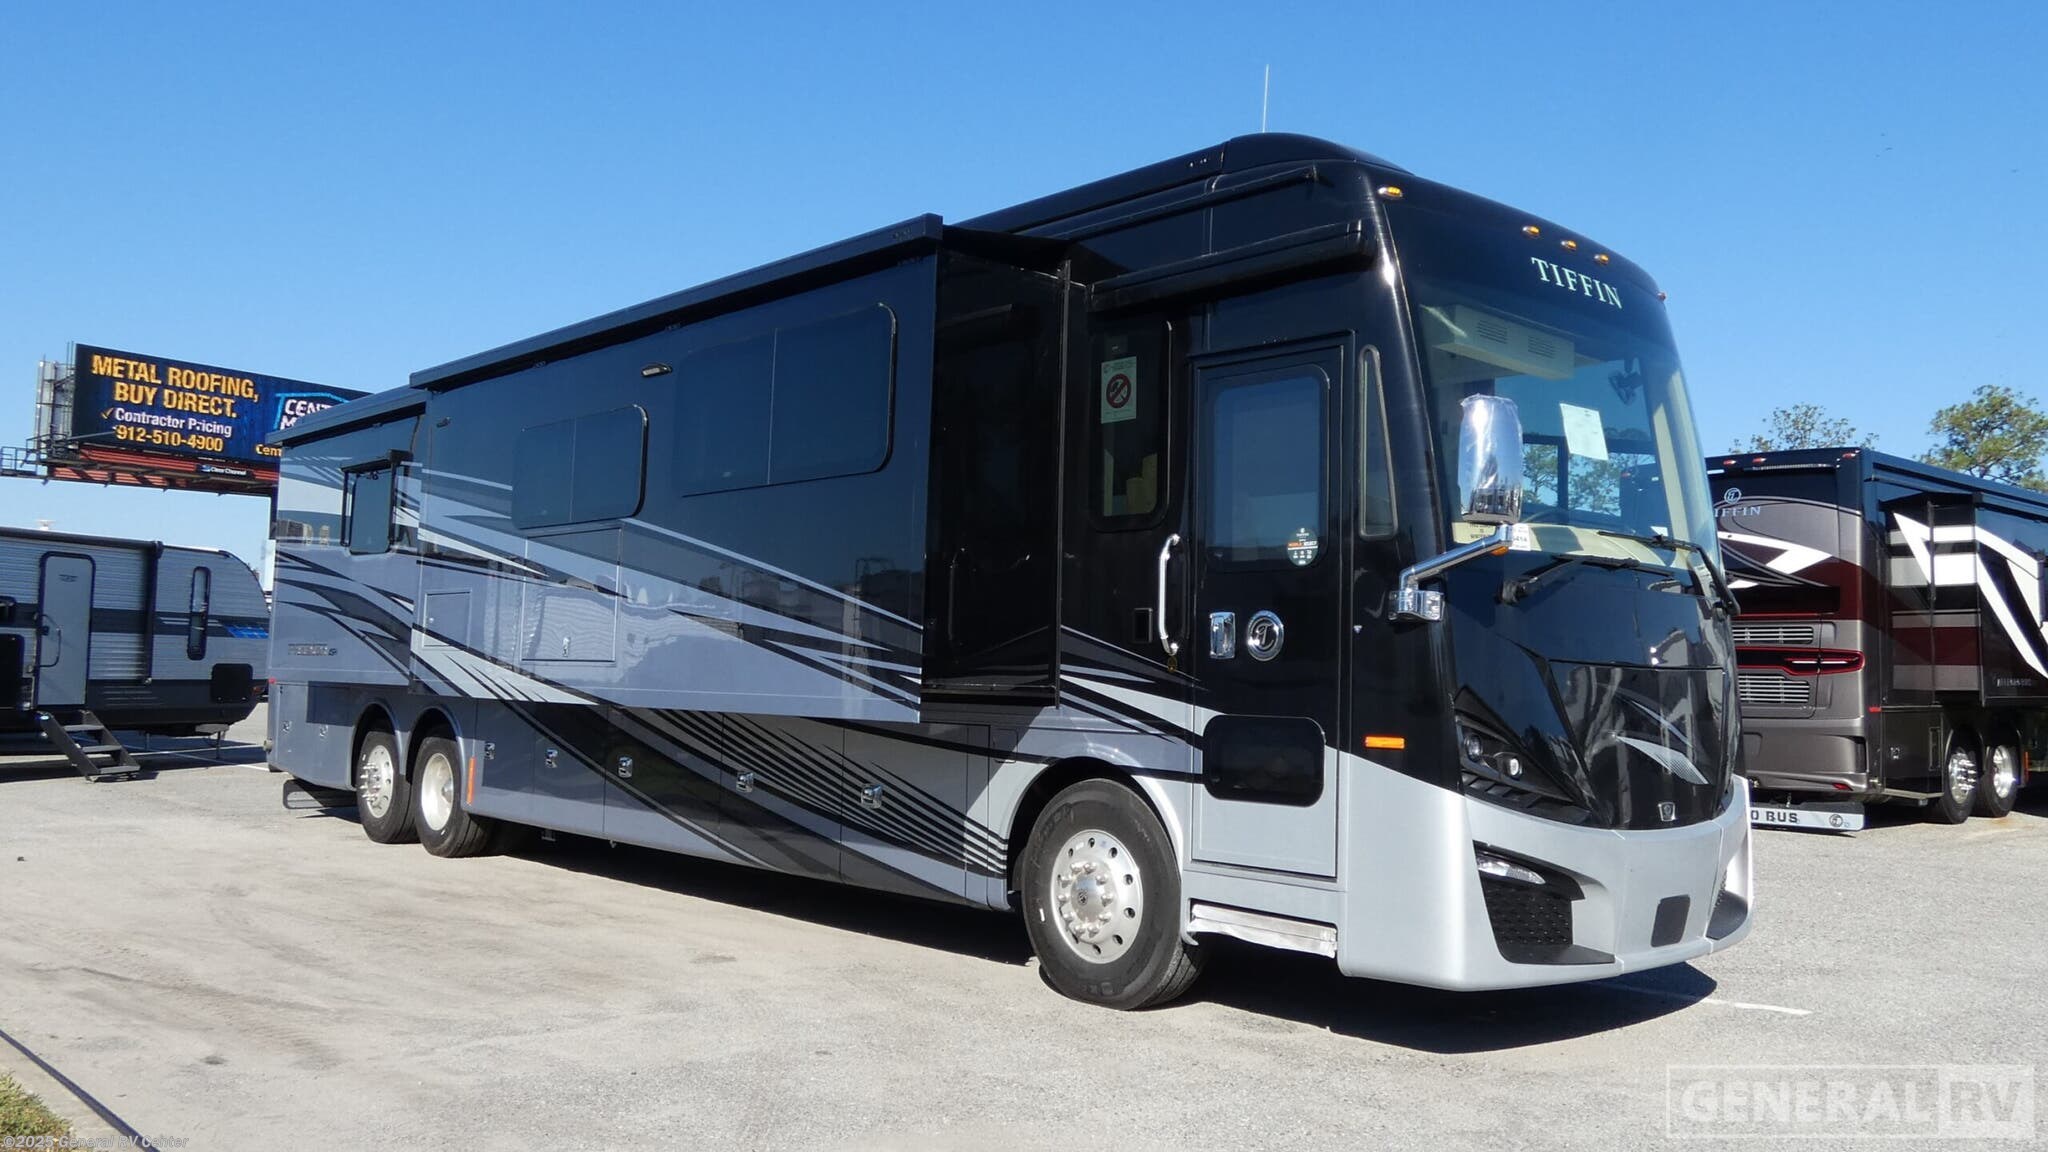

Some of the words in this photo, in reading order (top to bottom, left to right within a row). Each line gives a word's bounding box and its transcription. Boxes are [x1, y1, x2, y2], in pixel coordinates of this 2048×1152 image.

[1530, 256, 1623, 309] TIFFIN
[92, 354, 162, 385] METAL
[167, 366, 259, 402] ROOFING,
[114, 381, 158, 406] BUY
[162, 388, 237, 418] DIRECT.
[115, 407, 186, 430] Contractor
[187, 417, 232, 438] Pricing
[115, 424, 224, 452] 912-510-4900
[1714, 505, 1761, 518] IFFIN
[1765, 810, 1799, 823] BUS
